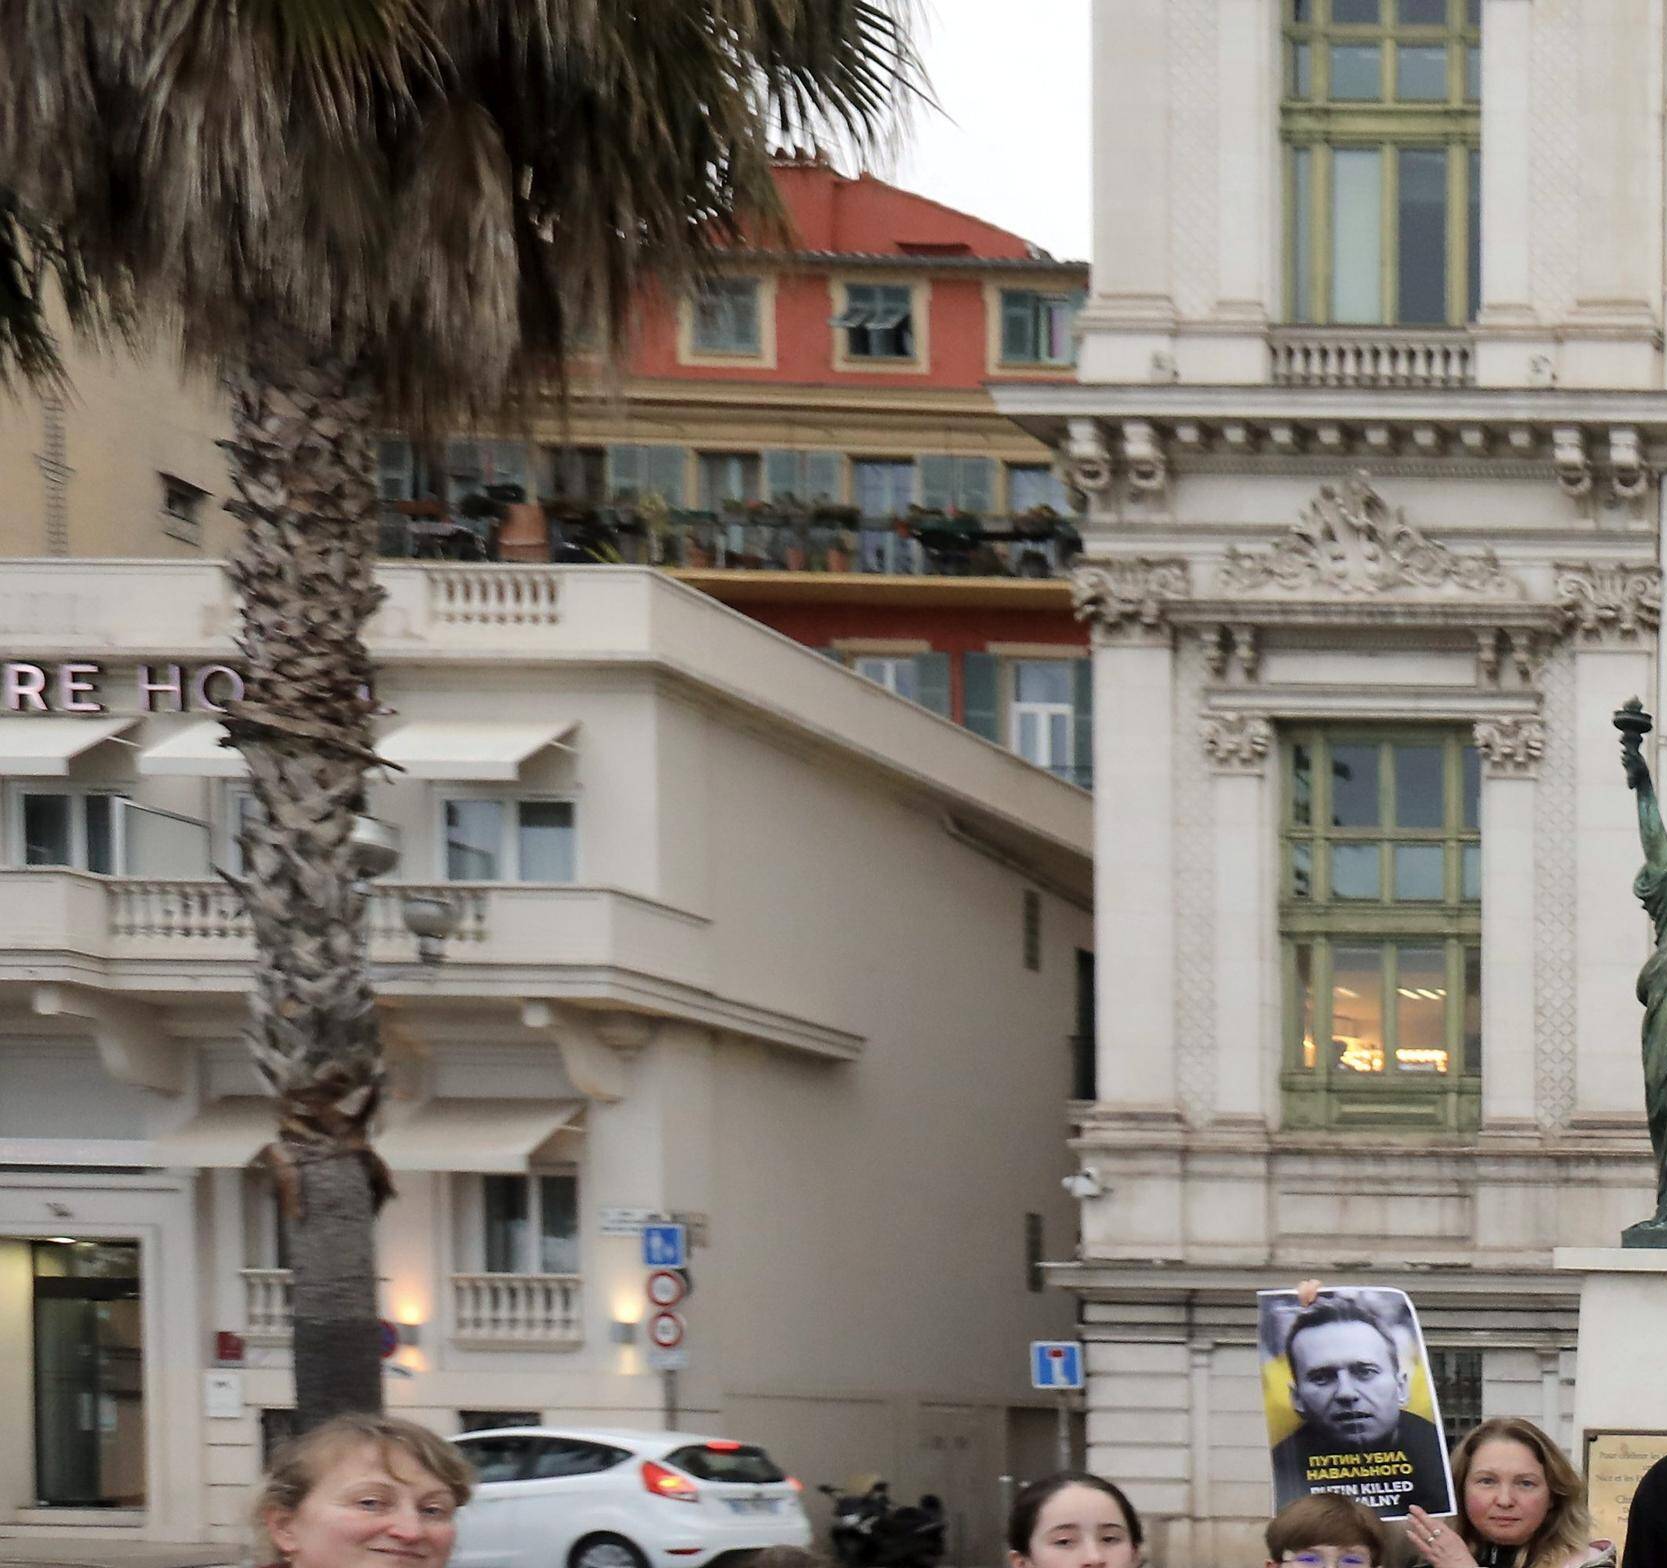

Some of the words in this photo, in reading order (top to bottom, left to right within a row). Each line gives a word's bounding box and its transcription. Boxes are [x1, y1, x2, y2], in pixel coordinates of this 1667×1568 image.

[1309, 1454, 1360, 1467] ПУТИН
[1364, 1451, 1407, 1463] УБИЛ
[1306, 1463, 1413, 1480] НАВАЛЬНОГО
[1361, 1481, 1414, 1494] KILLED
